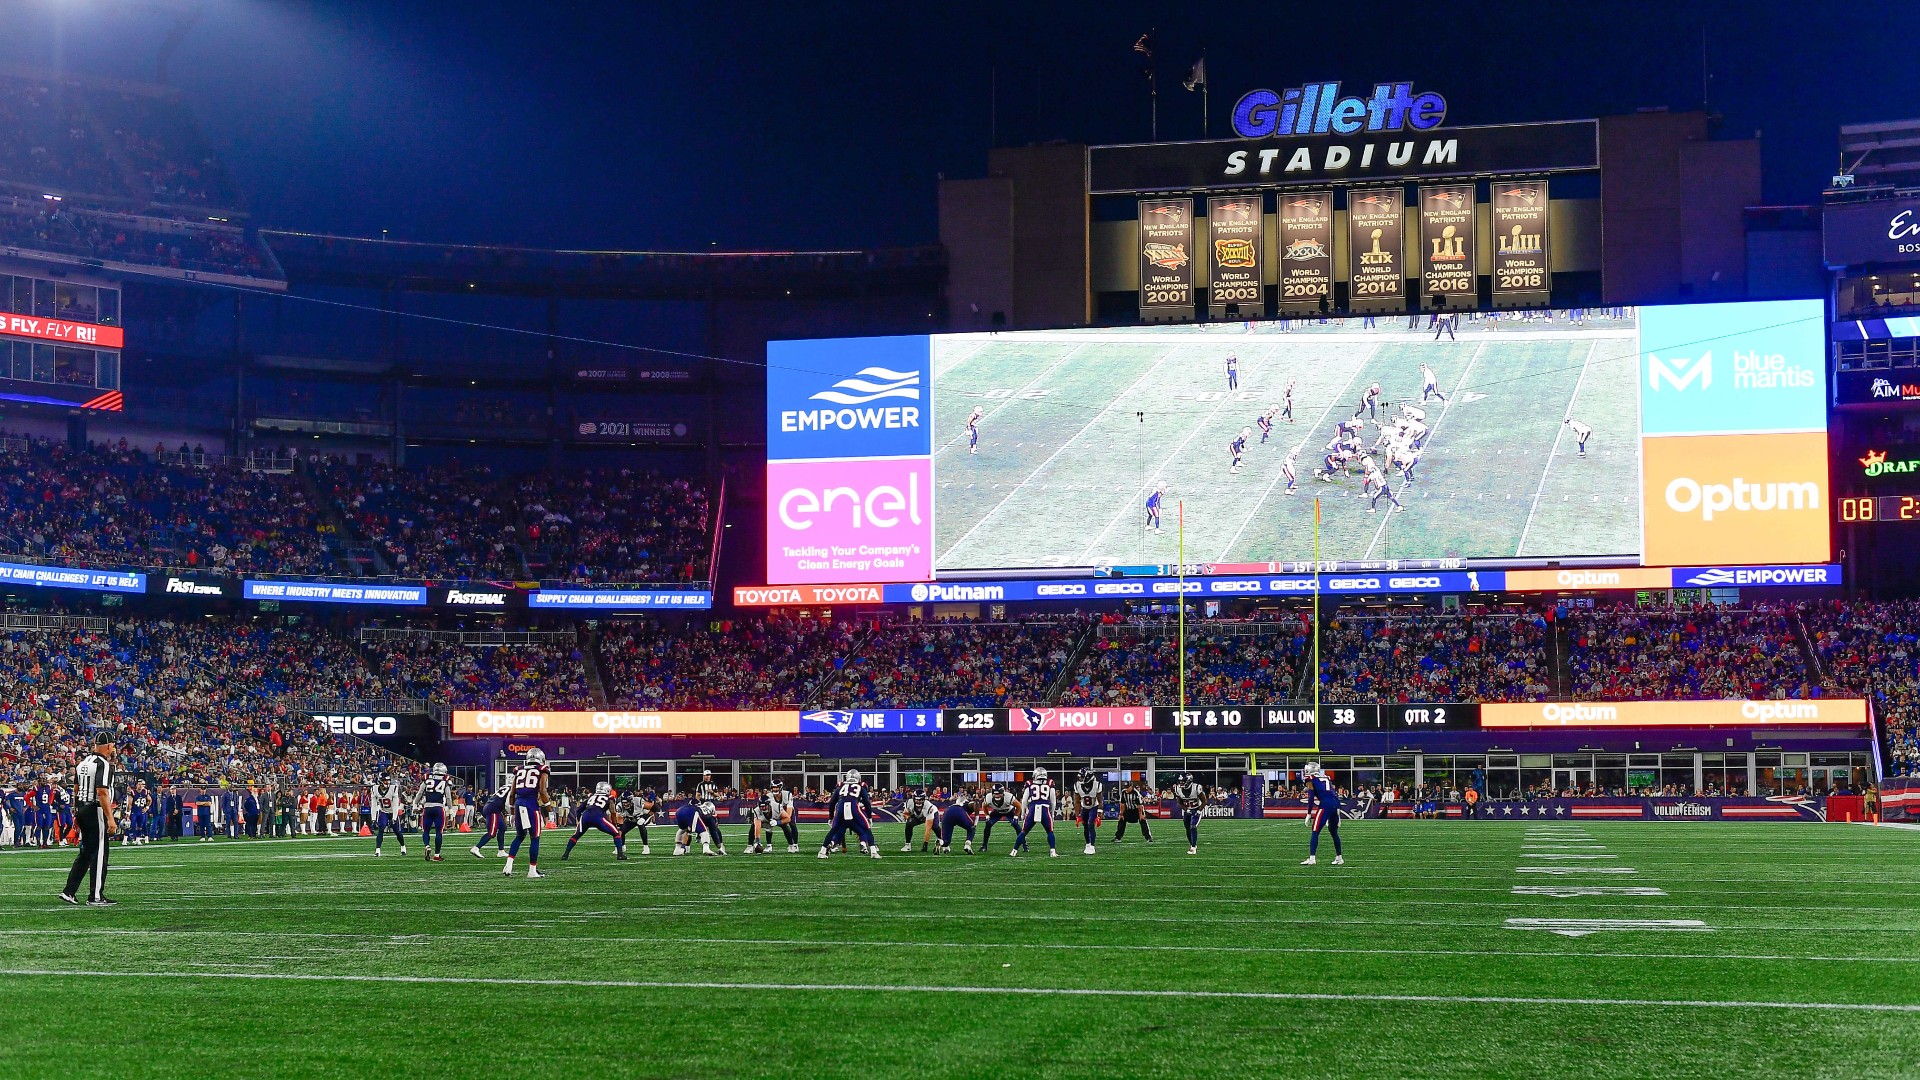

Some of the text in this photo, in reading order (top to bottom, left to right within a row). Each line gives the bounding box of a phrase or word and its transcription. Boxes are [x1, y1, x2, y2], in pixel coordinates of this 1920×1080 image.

[1232, 82, 1446, 138] Gillette
[1223, 139, 1458, 175] STADIUM
[1360, 254, 1393, 264] XLIX
[1497, 268, 1544, 276] CHAMPIONS
[1356, 282, 1397, 294] 2014
[1428, 279, 1468, 291] 2016
[1500, 276, 1541, 288] 2018
[1147, 291, 1186, 303] 2001
[1214, 288, 1258, 300] 2003
[1284, 284, 1328, 296] 2004
[11, 318, 42, 334] FLY.
[46, 322, 73, 337] FLY
[76, 326, 96, 341] RI!
[1734, 350, 1784, 370] blue
[1734, 366, 1816, 388] mantis
[1874, 385, 1900, 398] AIM
[782, 406, 920, 432] EMPOWER
[600, 423, 630, 436] 2021
[779, 472, 922, 530] enel
[1665, 478, 1819, 521] Optum
[1843, 498, 1873, 520] 08
[783, 544, 920, 558] Tackling Your Company's
[798, 557, 904, 570] Clean Energy Goals
[1158, 566, 1164, 575] 3
[1177, 564, 1197, 574] 225
[1268, 564, 1276, 572] 0
[1293, 562, 1310, 572] 1ST
[1326, 562, 1338, 572] 10
[1386, 560, 1398, 570] 38
[1440, 560, 1461, 568] 2ND
[13, 568, 35, 580] CHAIN
[36, 571, 89, 583] CHALLENGES?
[92, 575, 106, 585] LET
[108, 576, 118, 586] US
[118, 577, 138, 588] HELP.
[1557, 570, 1620, 588] Optum
[1736, 568, 1827, 584] EMPOWER
[252, 584, 420, 600] WHERE INDUSTRY MEETS INNOVATION
[929, 584, 1004, 600] Putnam
[1037, 577, 1441, 596] GEICO GEICO GEICO GEICO GEICO GEICO GEICO
[446, 590, 505, 604] FASTENAL
[536, 594, 704, 604] SUPPLY CHAIN CHALLENGES? LET US HELP.
[736, 588, 880, 603] TOYOTA TOYOTA
[1172, 710, 1242, 726] 1ST & 10
[1268, 708, 1356, 724] BALL ON 38
[1405, 708, 1446, 724] QTR 2
[1543, 700, 1818, 724] Optum Optum
[476, 712, 662, 730] Optum Optum
[861, 714, 926, 729] NE 3
[958, 714, 994, 729] 2:25
[1060, 712, 1134, 727] HOU 0
[516, 769, 540, 788] 26
[1318, 778, 1330, 790] 7
[426, 780, 446, 794] 24
[839, 784, 862, 798] 43
[1030, 784, 1050, 800] 39
[42, 794, 48, 804] 9
[134, 798, 146, 808] 49
[587, 796, 609, 807] 45
